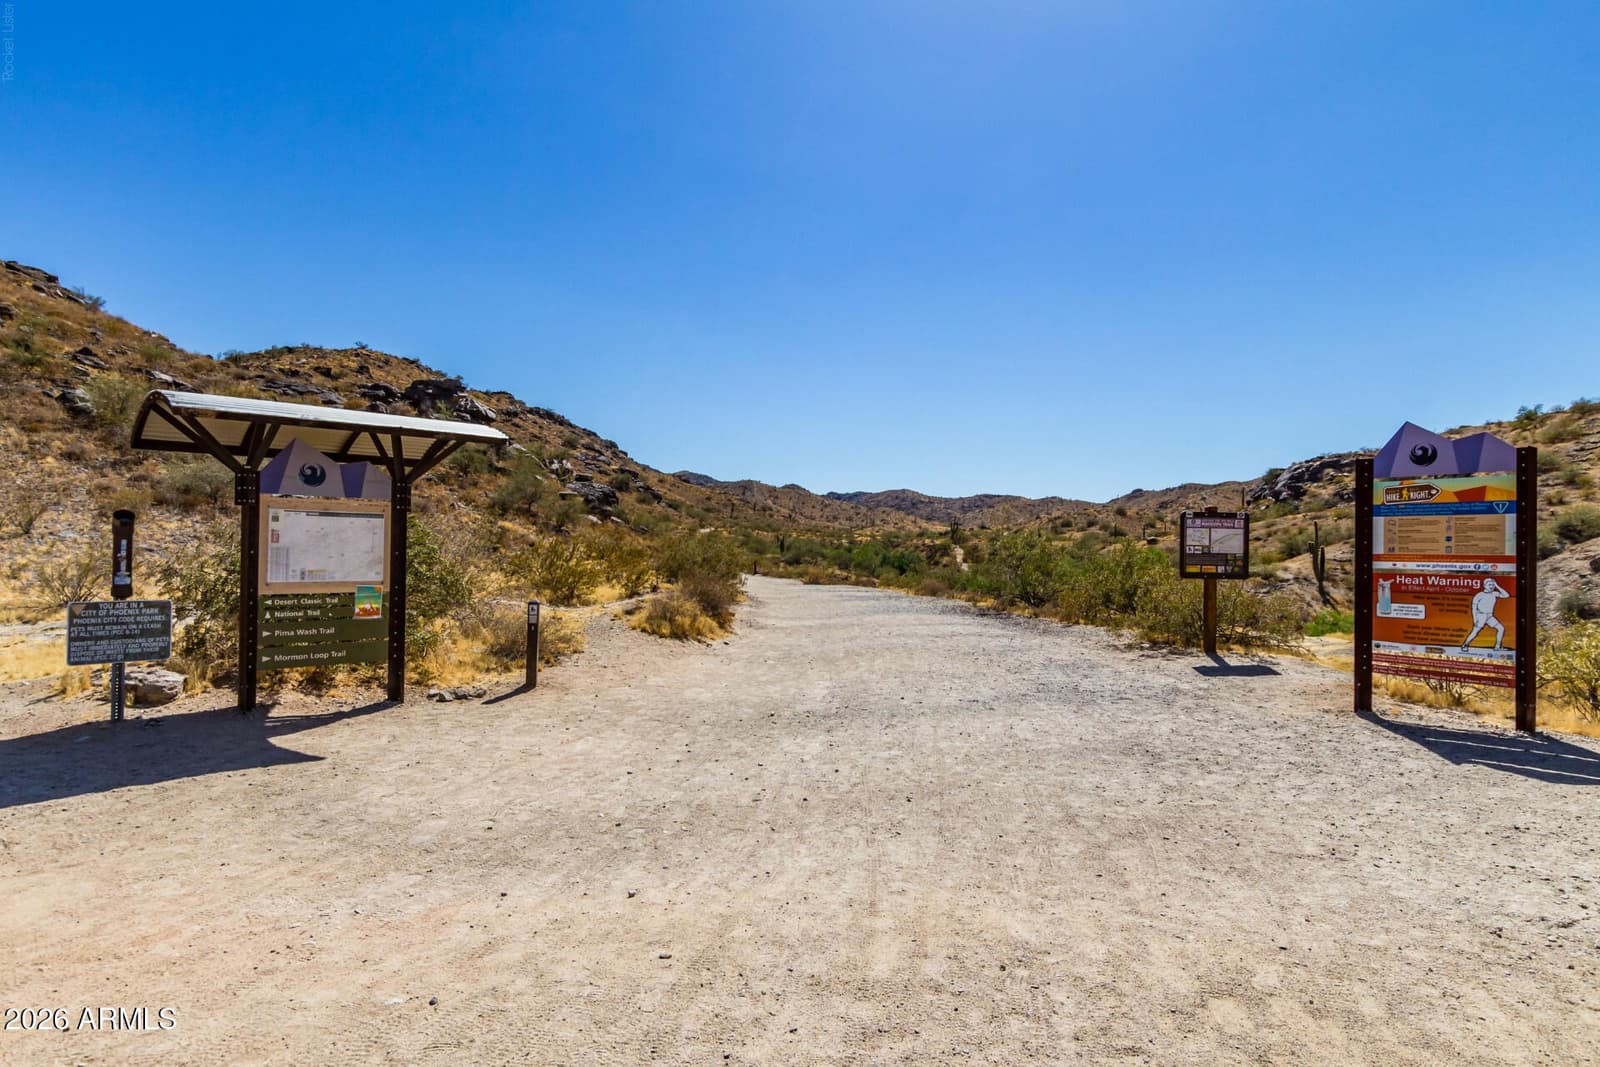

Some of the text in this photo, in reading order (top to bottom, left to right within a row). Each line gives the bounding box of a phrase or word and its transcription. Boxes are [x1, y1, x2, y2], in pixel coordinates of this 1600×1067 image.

[1396, 575, 1481, 589] Heat Warning
[109, 608, 139, 616] PHOENIX
[73, 617, 102, 625] PHOENIX
[274, 629, 295, 637] Pima
[319, 626, 335, 634] Trail
[274, 650, 346, 662] Mormon Loop Trail
